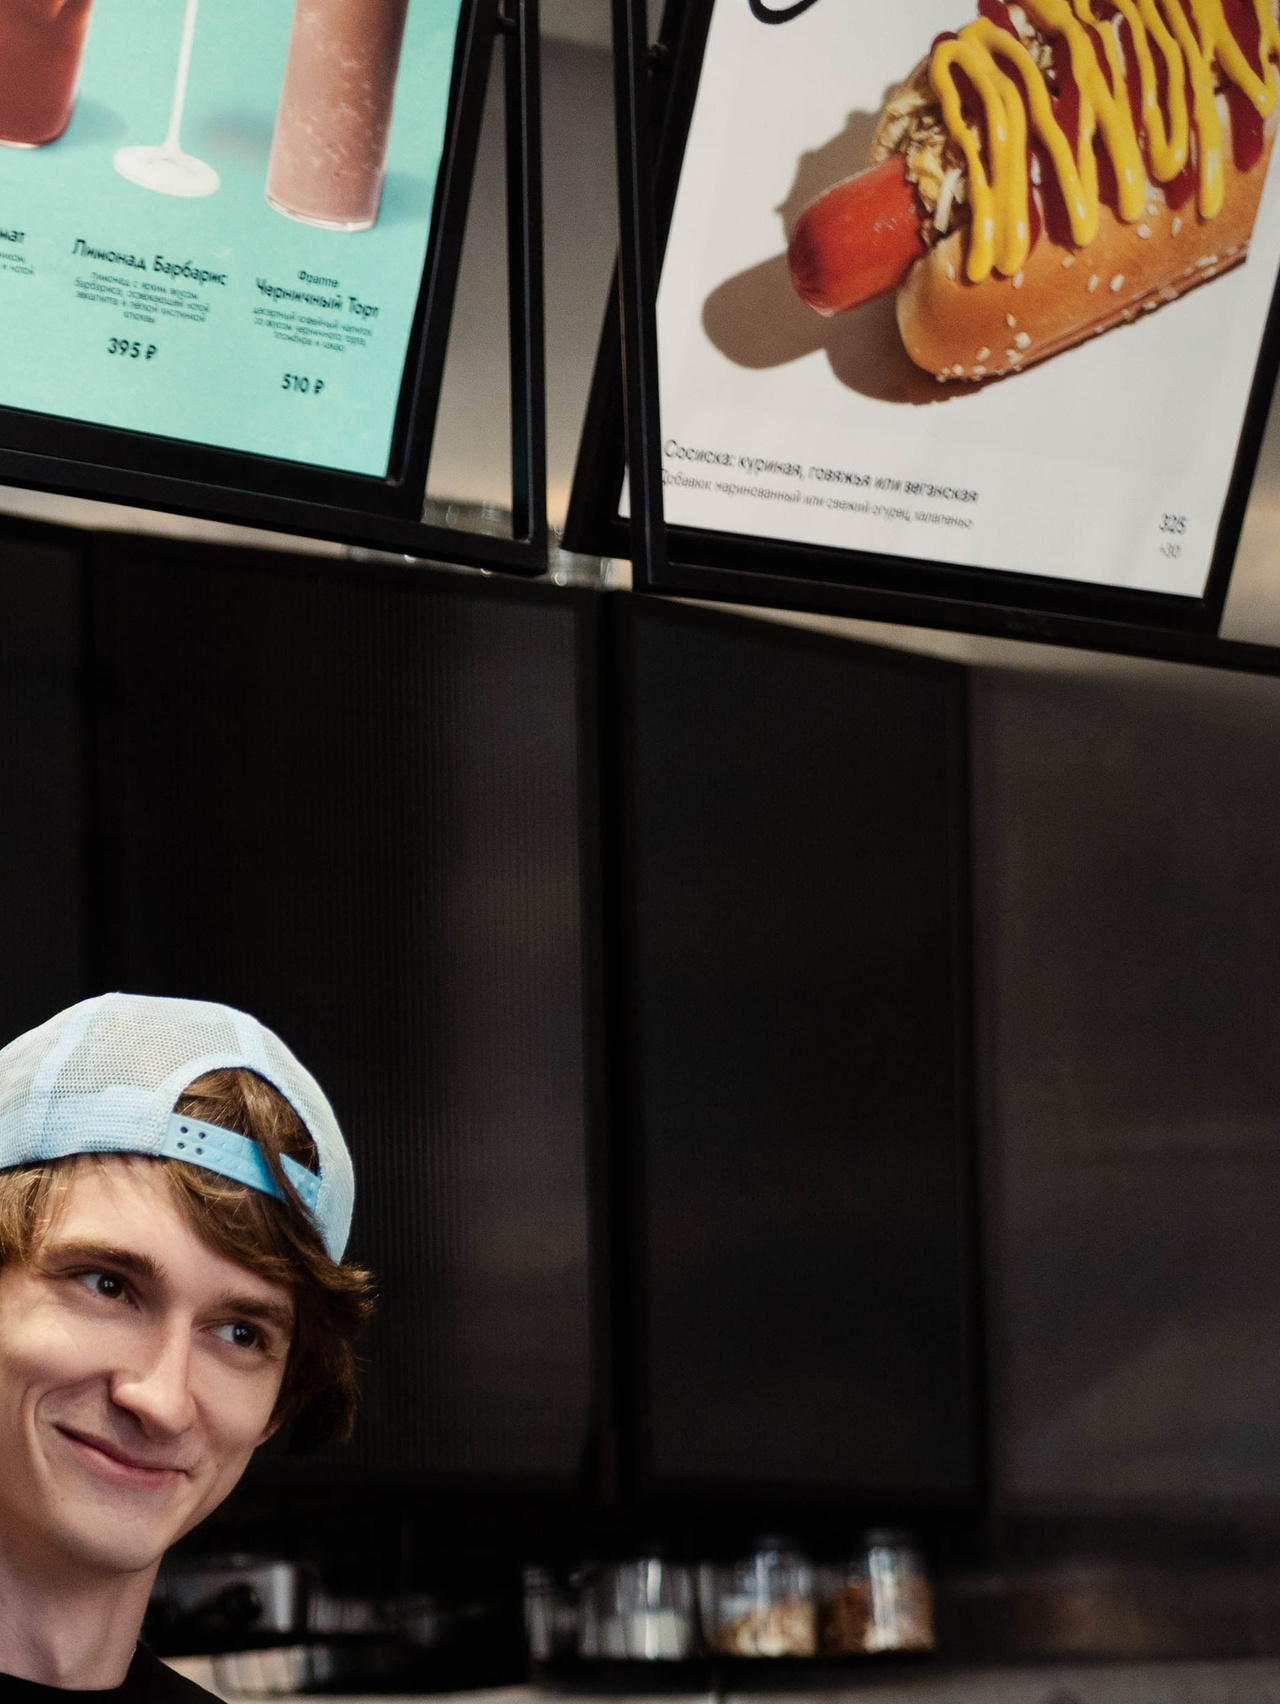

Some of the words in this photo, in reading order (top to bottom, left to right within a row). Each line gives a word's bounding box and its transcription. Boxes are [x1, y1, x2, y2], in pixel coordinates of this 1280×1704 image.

[71, 238, 147, 271] Лимонад
[152, 253, 228, 286] Барбарис
[296, 269, 339, 289] Фраппе
[256, 276, 344, 311] Черничный
[348, 295, 380, 321] Торт
[107, 336, 142, 359] 395
[145, 343, 158, 361] ₽
[281, 371, 310, 393] 510
[314, 378, 325, 395] ₽
[807, 464, 871, 487] говяжья
[873, 475, 903, 492] или
[903, 480, 979, 503] веганская
[1158, 512, 1187, 535] 325
